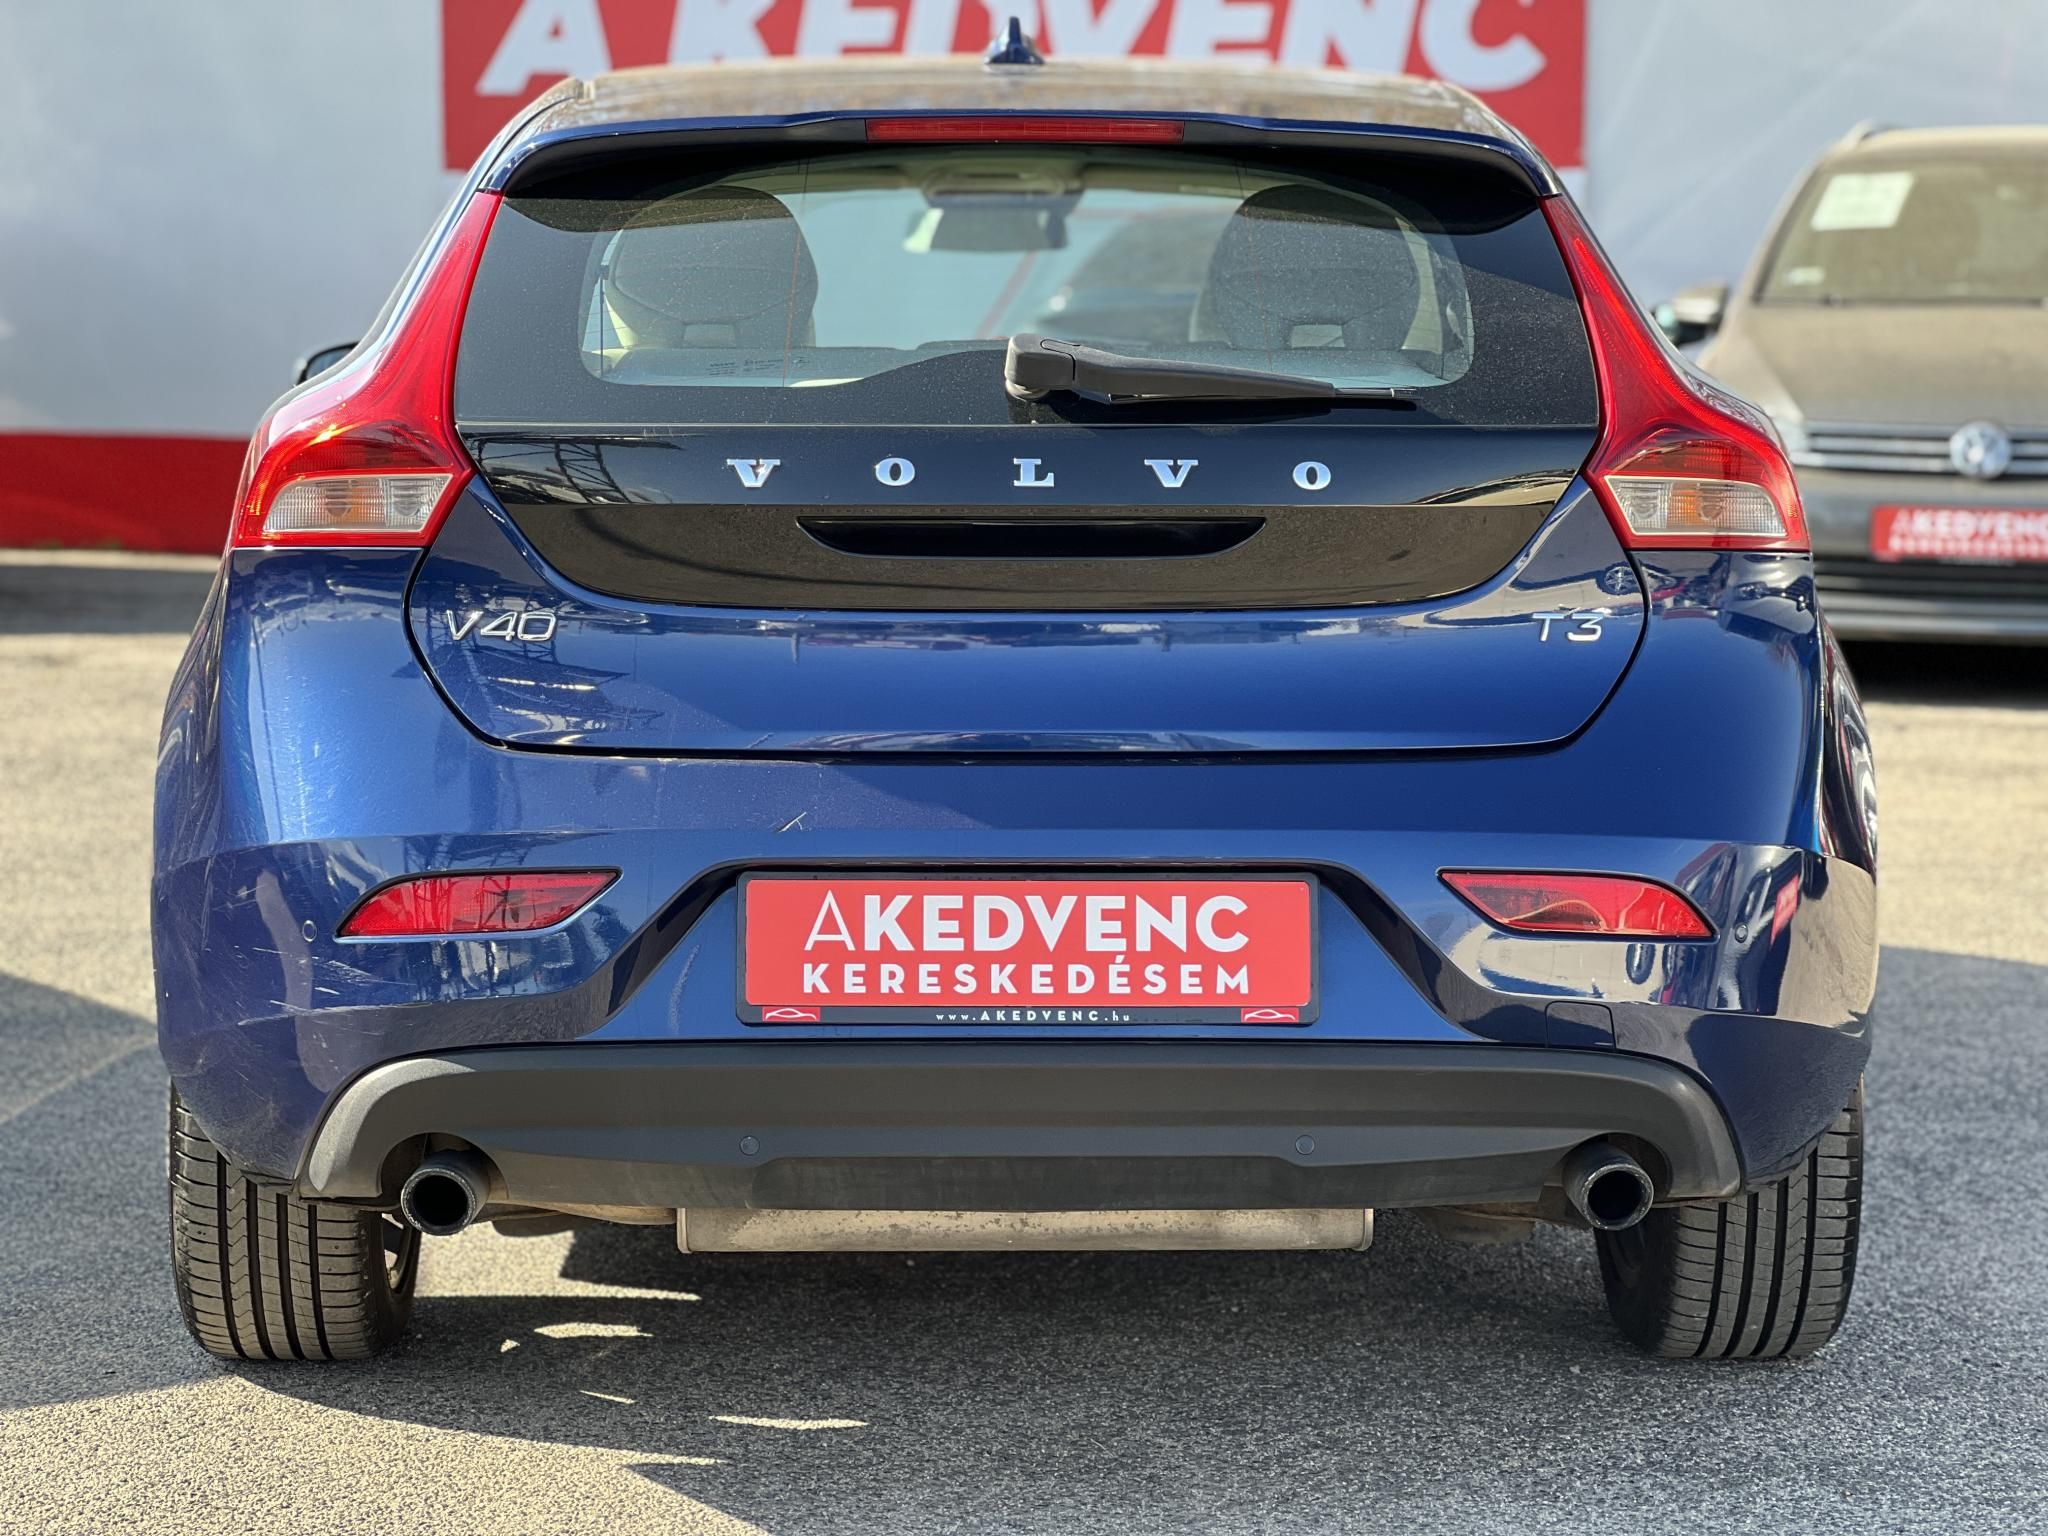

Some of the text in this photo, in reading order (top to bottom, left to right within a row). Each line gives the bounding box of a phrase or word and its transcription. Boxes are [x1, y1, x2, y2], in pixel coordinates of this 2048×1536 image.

[475, 0, 614, 95] A
[727, 457, 1332, 491] VOLVO
[446, 609, 558, 641] V40
[1532, 611, 1604, 643] T3
[803, 955, 1250, 994] KERESKEDÉSEM
[936, 1010, 1130, 1021] www.AKEDVENC.hu
